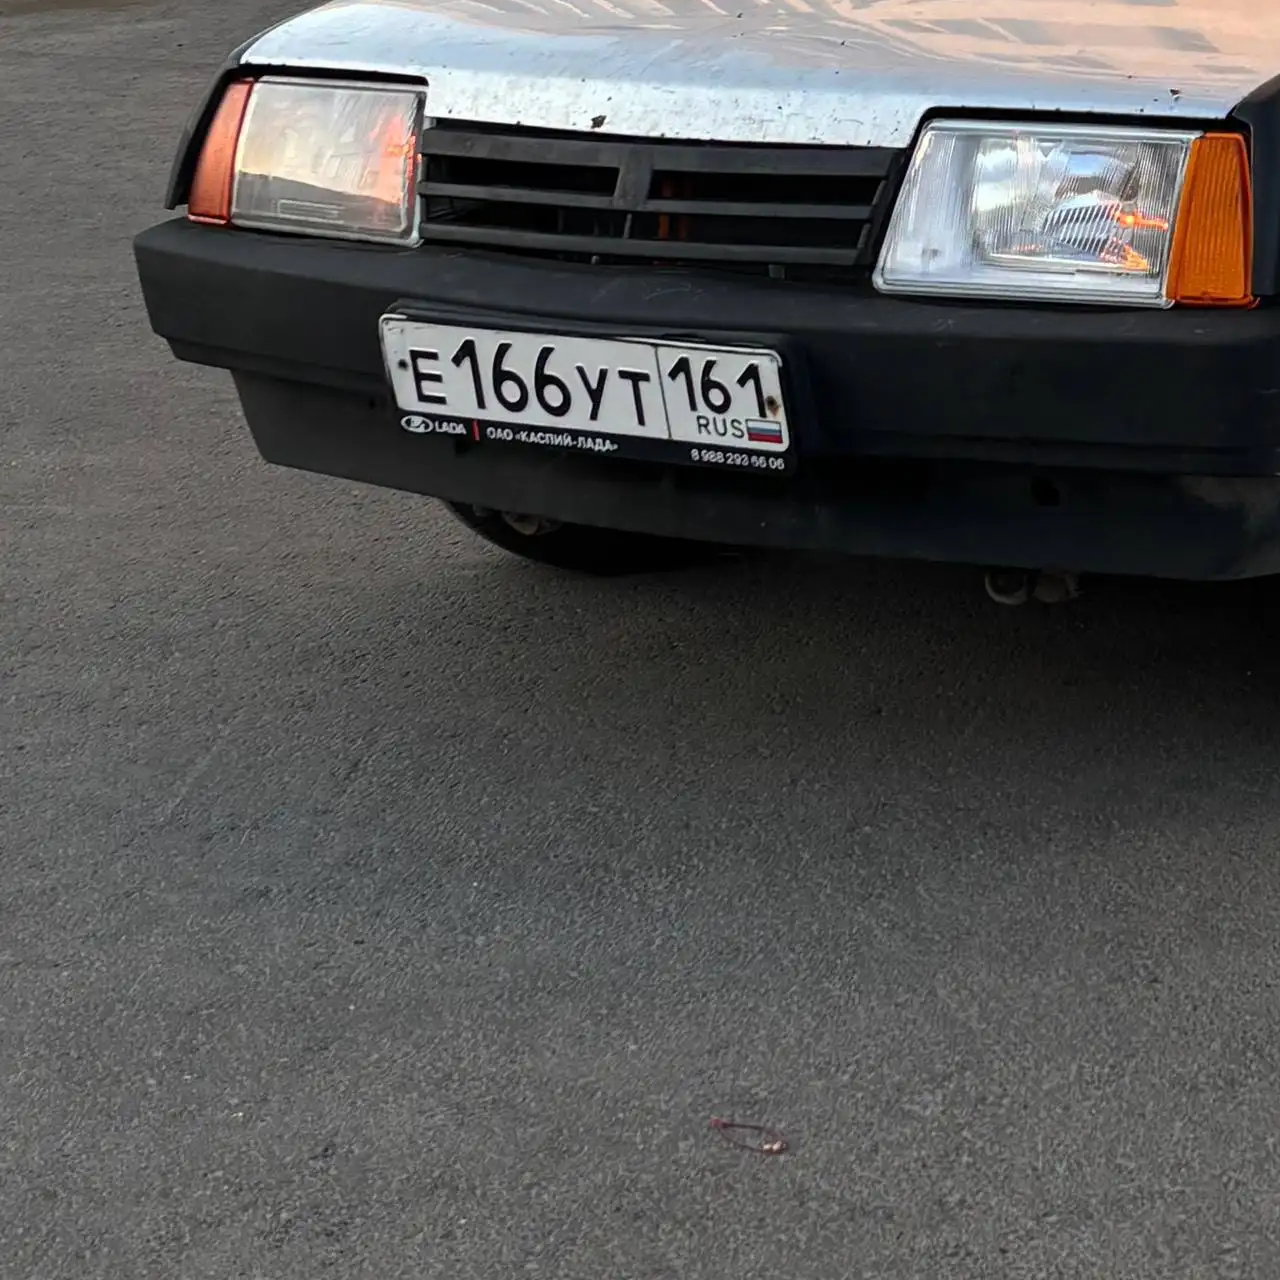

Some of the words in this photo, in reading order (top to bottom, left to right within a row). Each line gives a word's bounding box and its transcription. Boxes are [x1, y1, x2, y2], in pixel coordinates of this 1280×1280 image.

[668, 356, 768, 419] 161
[434, 421, 467, 435] LADA
[486, 427, 514, 441] ОАО
[697, 418, 745, 439] RUS
